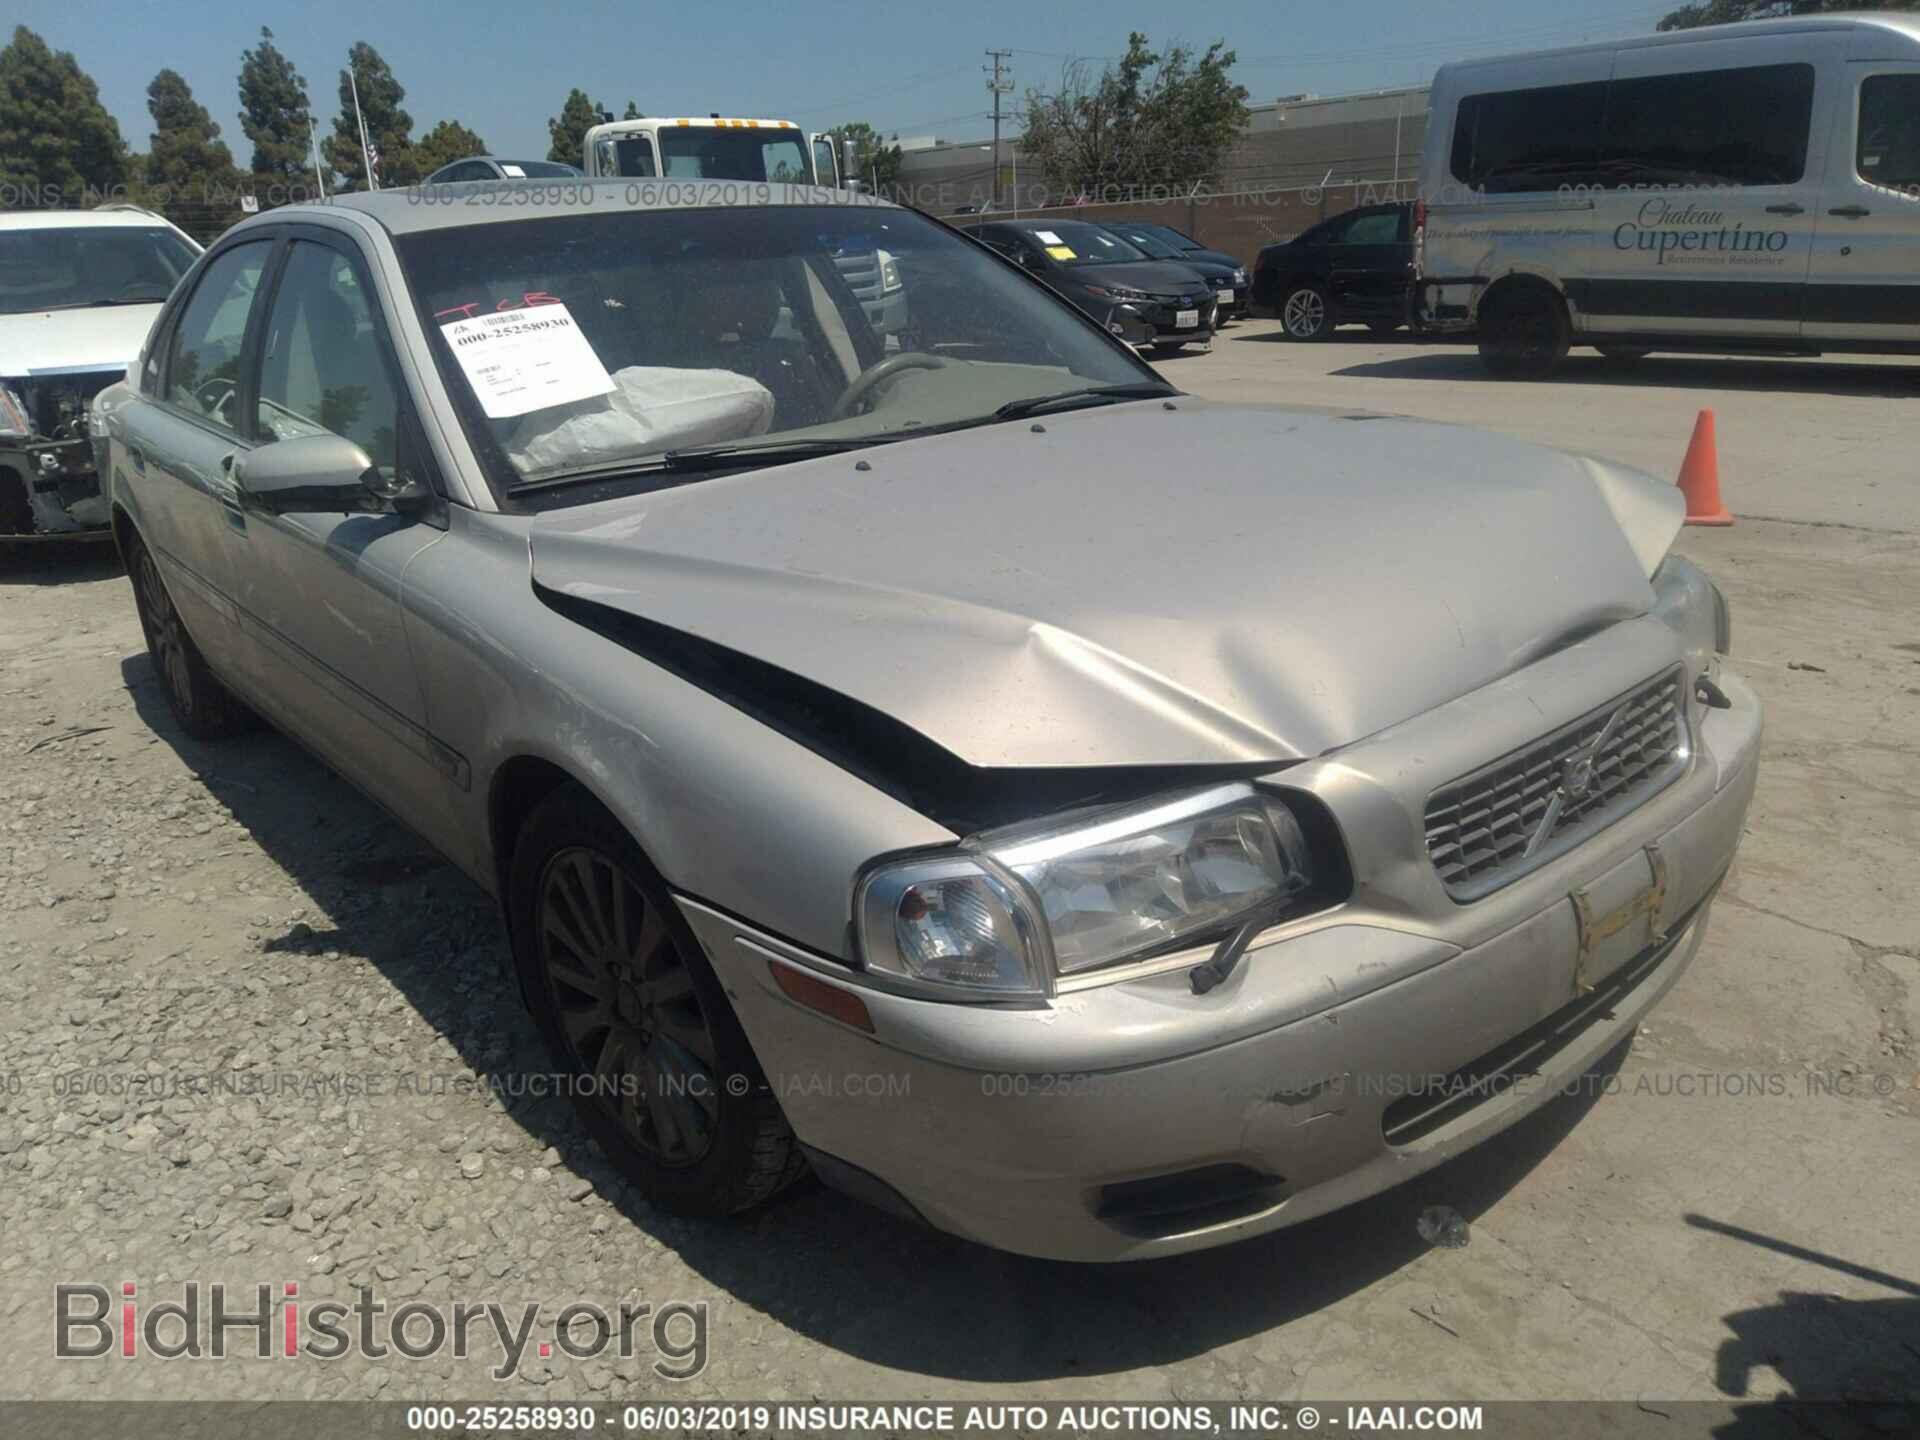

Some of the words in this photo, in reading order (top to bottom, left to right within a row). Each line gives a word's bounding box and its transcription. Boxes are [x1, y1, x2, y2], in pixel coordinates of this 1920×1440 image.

[1638, 198, 1723, 229] Chateau
[1614, 222, 1788, 265] Cupertino
[457, 318, 569, 347] 000-25258930
